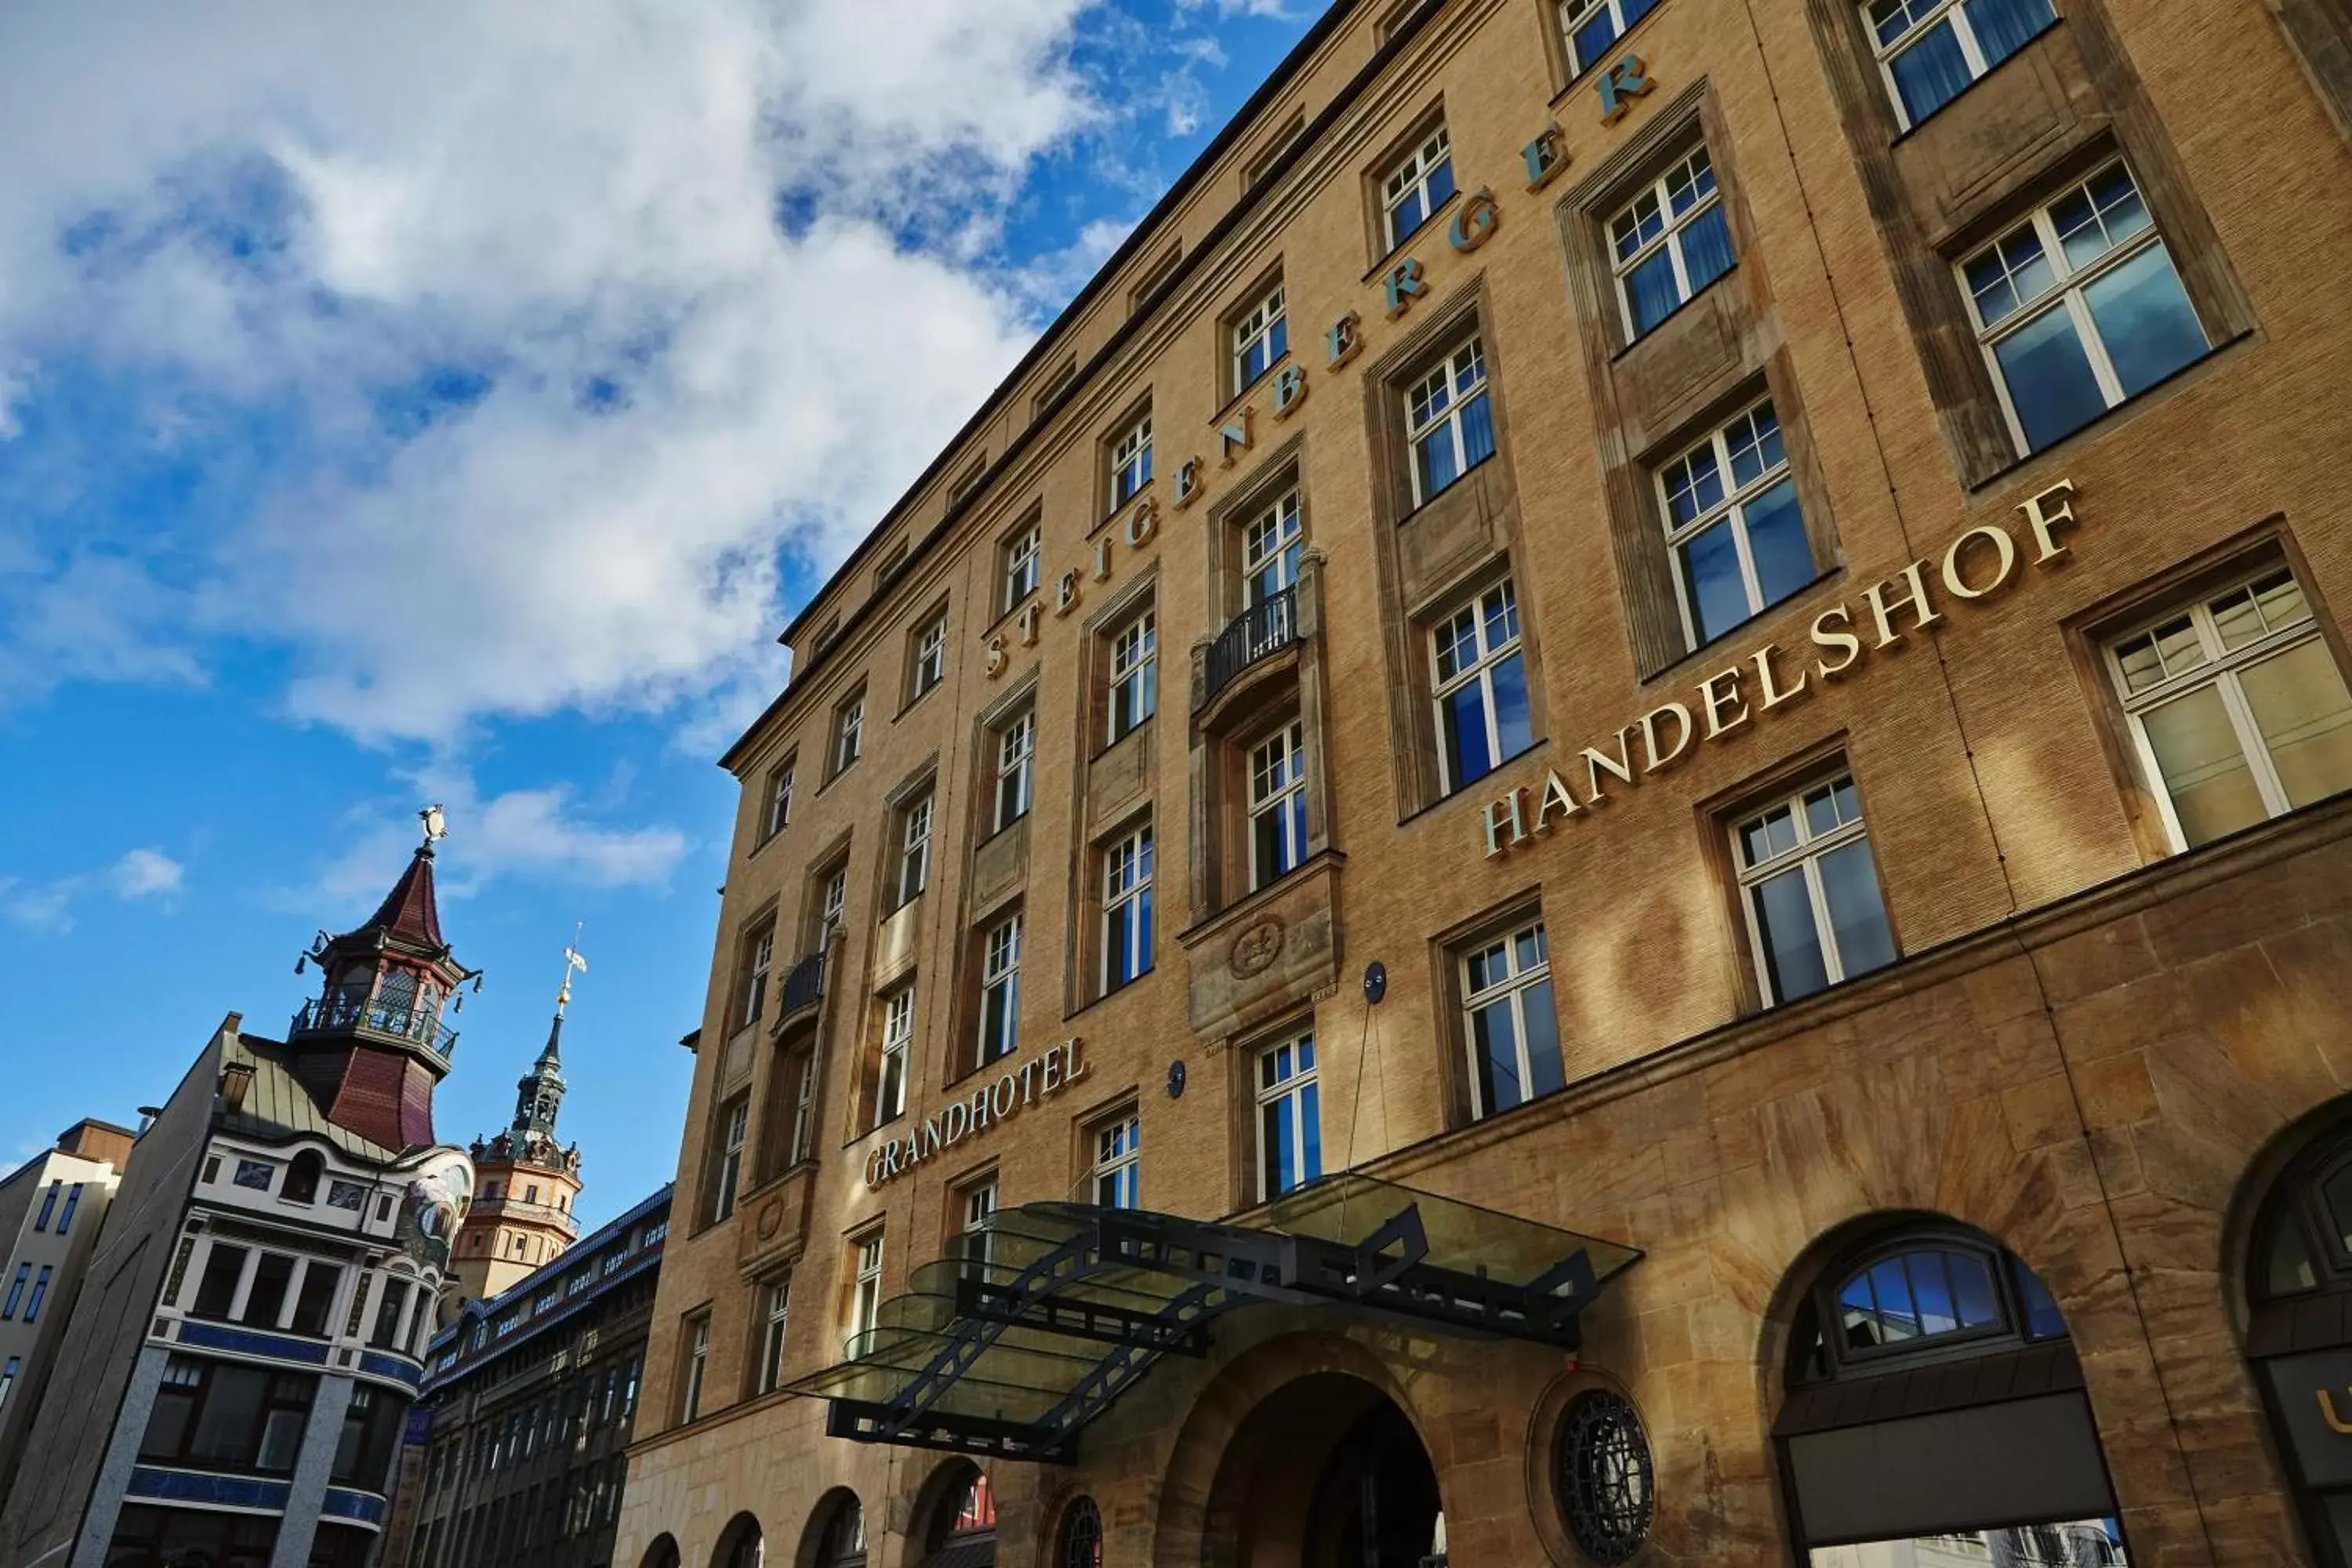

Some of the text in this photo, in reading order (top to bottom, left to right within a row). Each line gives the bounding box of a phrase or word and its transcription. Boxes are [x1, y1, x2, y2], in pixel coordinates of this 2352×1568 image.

[986, 52, 1656, 678] STEIGENBERGER
[1483, 477, 2078, 860] HANDELSHOF
[864, 1036, 1087, 1191] GRANDHOTEL
